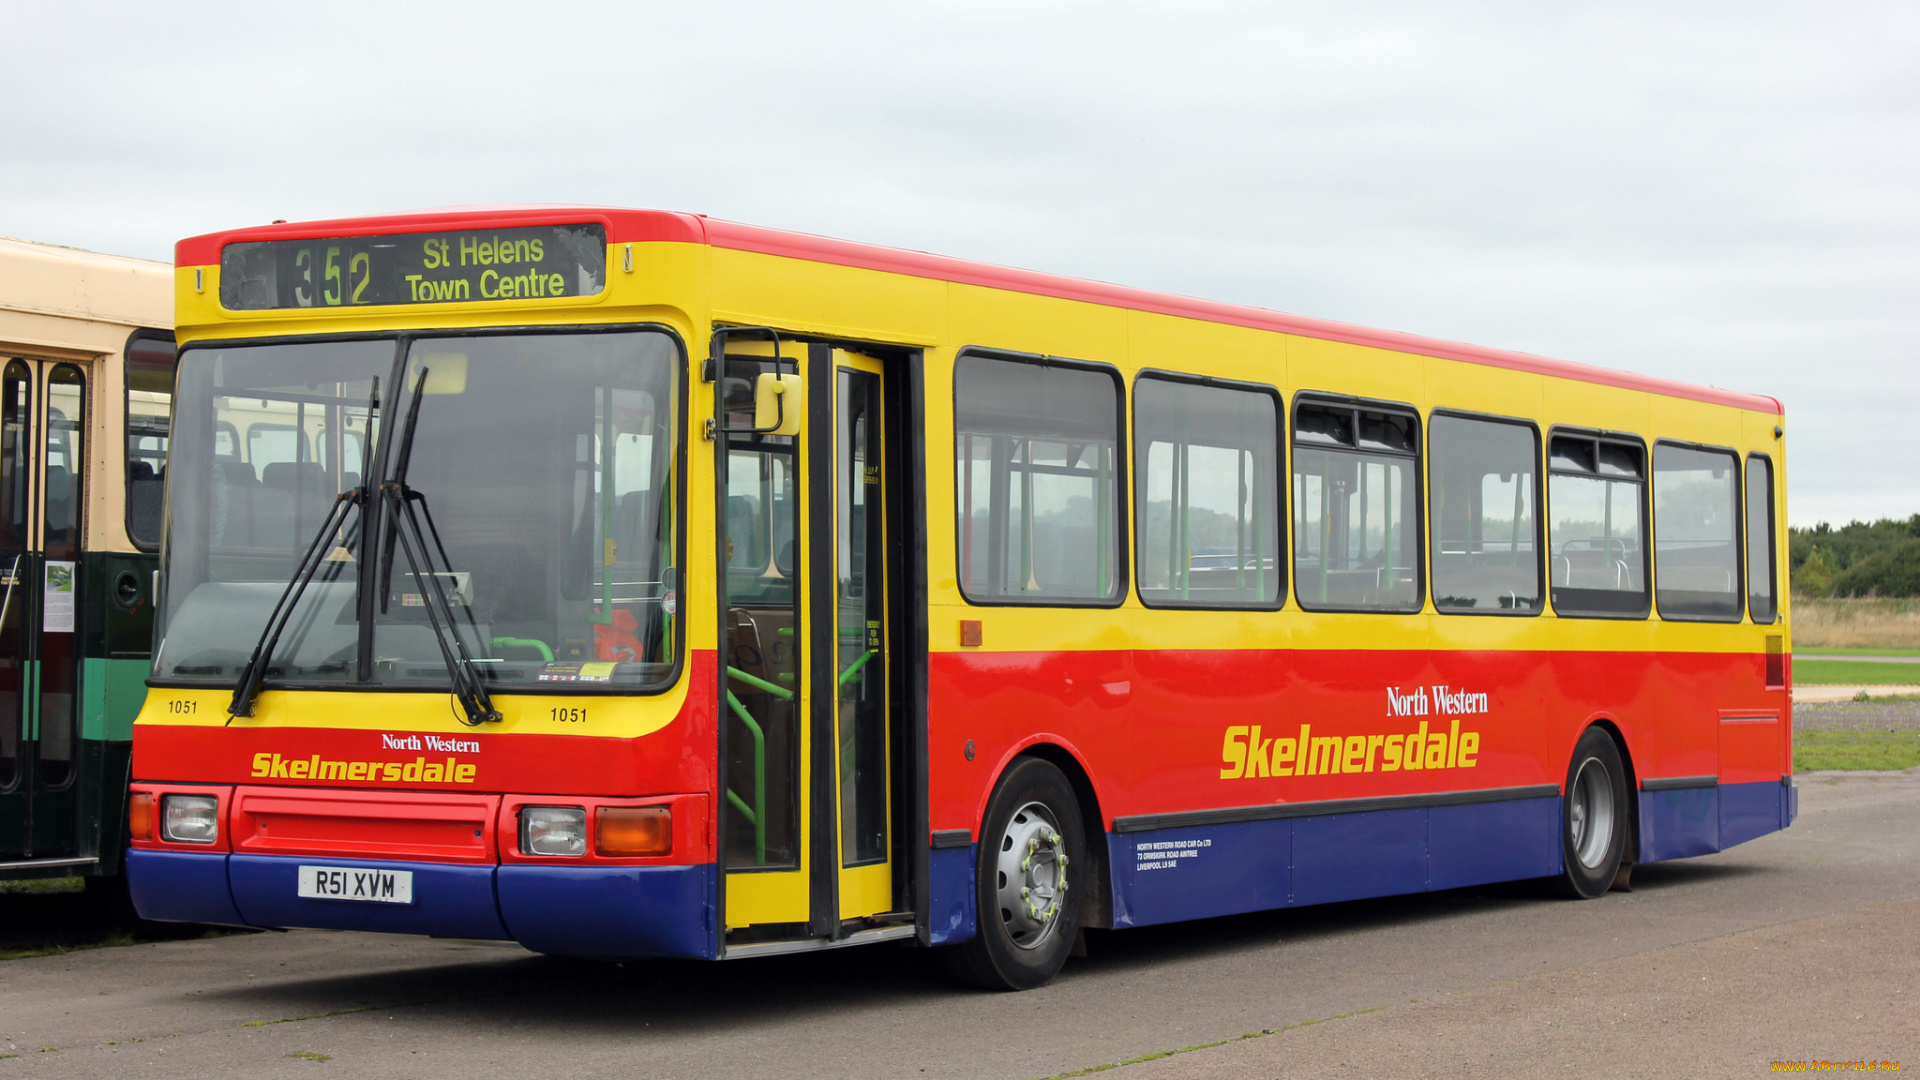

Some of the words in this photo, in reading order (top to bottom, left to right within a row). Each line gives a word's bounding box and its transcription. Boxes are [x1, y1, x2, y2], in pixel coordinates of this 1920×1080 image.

[423, 239, 450, 269] St
[460, 236, 545, 266] Helens
[295, 246, 371, 306] 352
[405, 274, 470, 302] Town
[479, 268, 565, 299] Centre
[168, 700, 197, 714] 1051
[550, 707, 587, 723] 1051
[1386, 686, 1428, 717] North
[1431, 685, 1488, 715] Western
[381, 733, 422, 751] North
[424, 735, 480, 753] Western
[1220, 719, 1480, 780] Skelmersdale
[251, 752, 477, 783] Skelmersdale
[1137, 843, 1153, 851] NORTH
[1153, 841, 1174, 849] WESTERN
[1174, 840, 1187, 848] ROAD
[1187, 840, 1196, 848] CAR
[1203, 839, 1211, 847] LTD
[1166, 850, 1179, 859] ROAD
[1180, 849, 1198, 857] AINTREE
[1137, 861, 1161, 871] LIVERPOOL
[316, 870, 347, 896] R51
[353, 872, 395, 898] XVM
